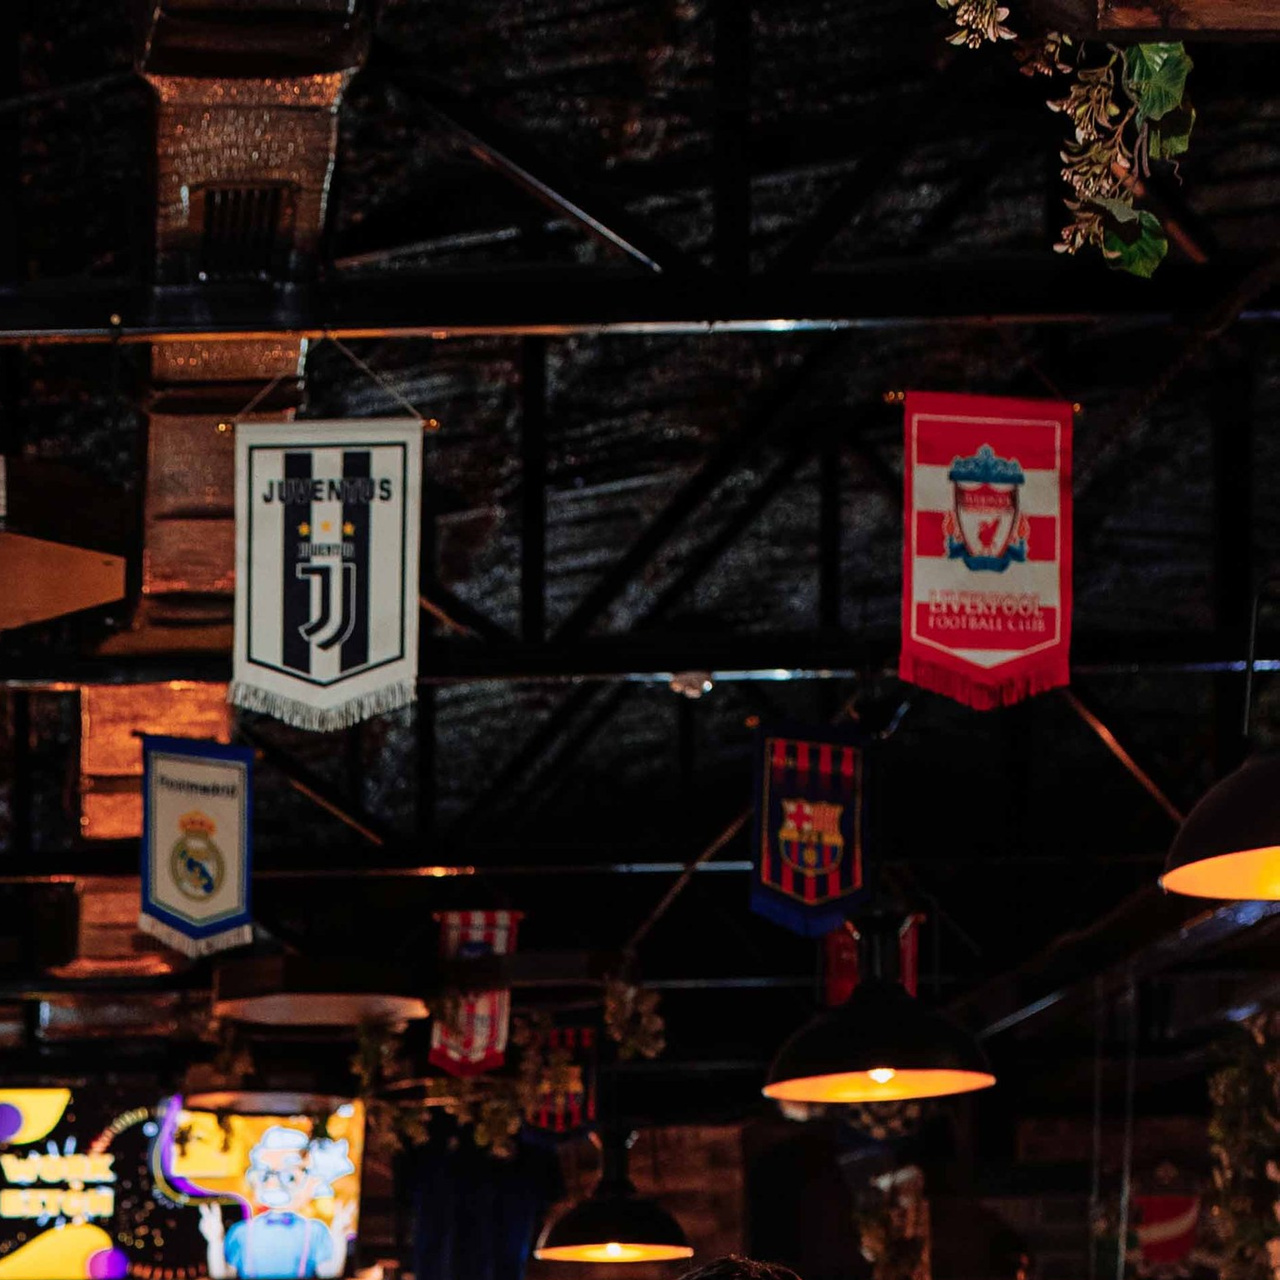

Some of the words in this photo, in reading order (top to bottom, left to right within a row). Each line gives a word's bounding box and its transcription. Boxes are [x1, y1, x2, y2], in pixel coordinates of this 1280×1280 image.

[261, 478, 393, 503] JUVENTUS
[928, 589, 1044, 618] LIVERPOOL
[928, 616, 1003, 632] FOOTBALL
[1007, 618, 1046, 633] CLUB
